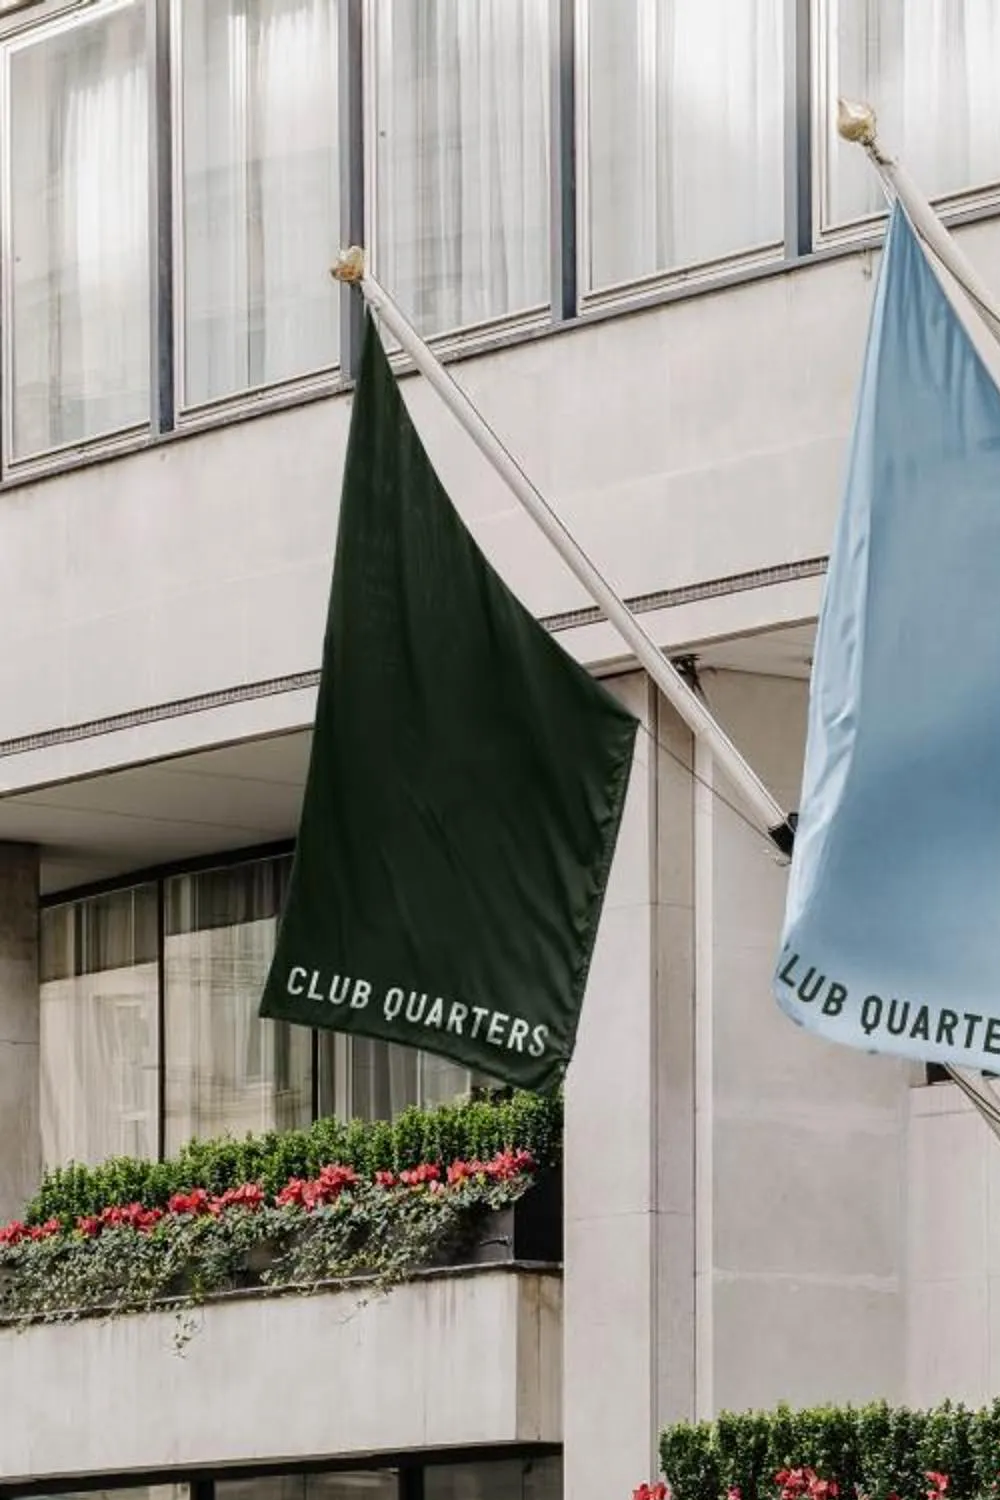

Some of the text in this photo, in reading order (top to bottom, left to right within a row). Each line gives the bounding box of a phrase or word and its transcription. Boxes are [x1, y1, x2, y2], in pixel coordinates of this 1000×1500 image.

[287, 967, 550, 1057] CLUB QUARTERS
[778, 944, 848, 1017] LUB
